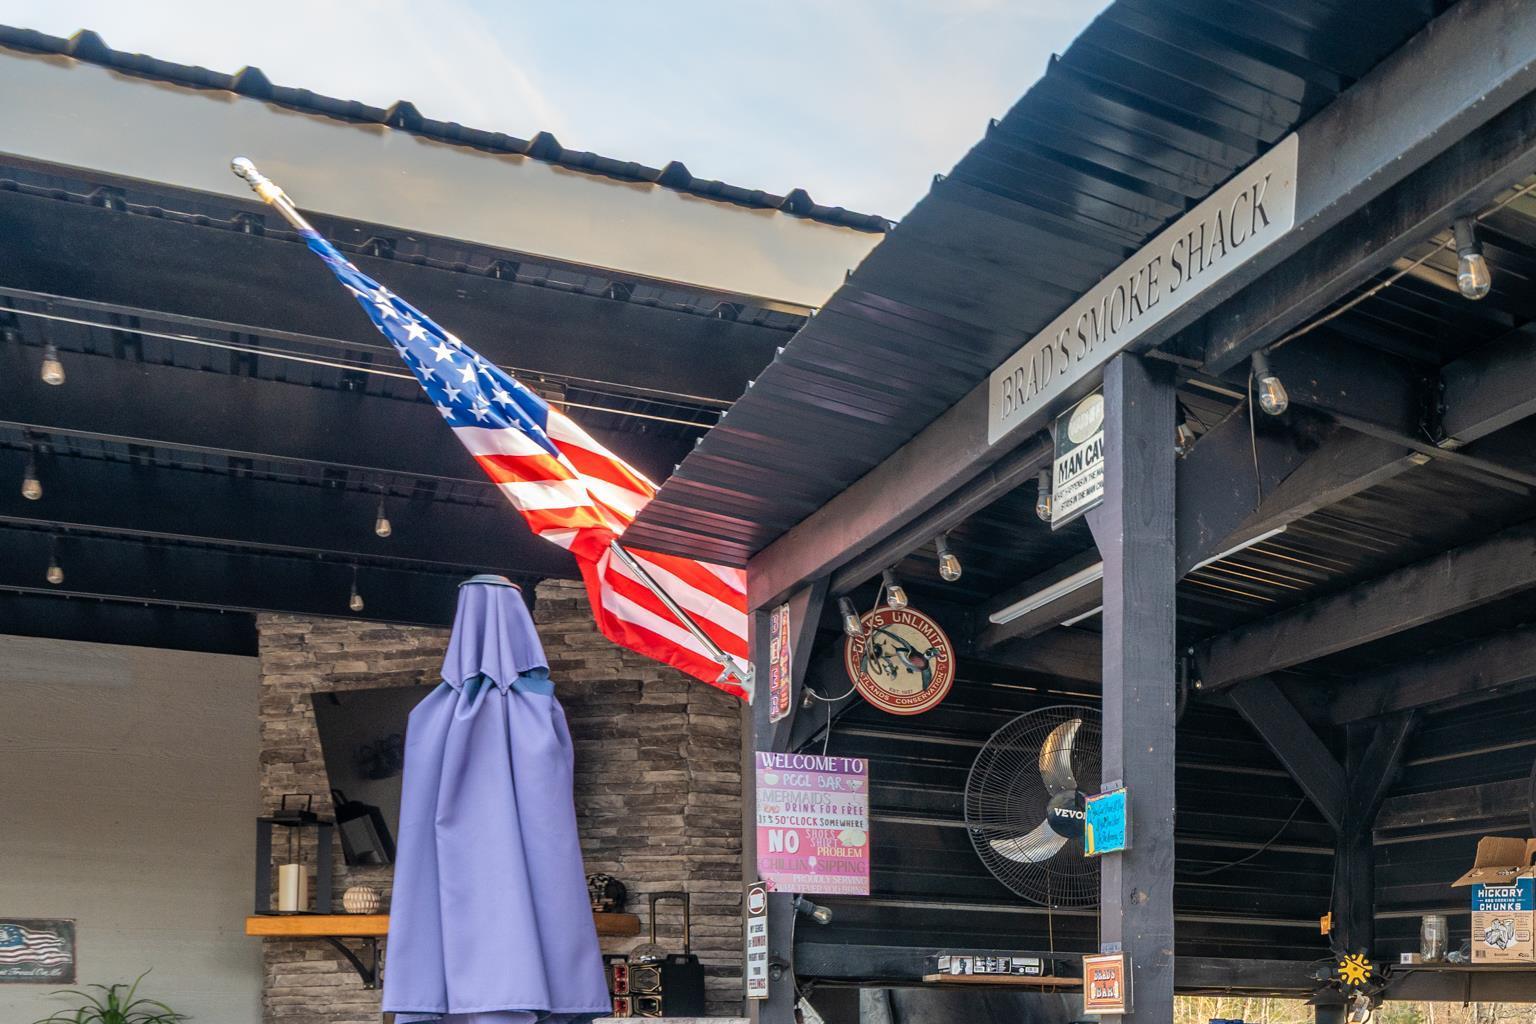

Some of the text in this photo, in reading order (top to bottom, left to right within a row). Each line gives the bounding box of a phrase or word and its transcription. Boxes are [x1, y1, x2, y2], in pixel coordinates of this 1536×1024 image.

[1001, 174, 1272, 420] BRAD'S SMOKE SHACK
[1058, 450, 1083, 484] MAN
[892, 611, 947, 662] UNLIMITED
[895, 673, 944, 704] CONSERVATION
[761, 753, 863, 773] WELCOME TO
[783, 773, 846, 791] POOL BAR
[762, 789, 832, 805] MERMAIDS
[785, 803, 864, 816] DRINK FOR FREE
[819, 817, 864, 828] SOMEWHERE
[767, 829, 800, 854] NO
[805, 829, 836, 840] SHOES
[810, 839, 838, 848] SHIRT
[817, 846, 862, 858] PROBLEM
[818, 859, 866, 874] SIPPING
[1478, 888, 1524, 898] HICKORY
[1479, 902, 1521, 911] CHUNKS
